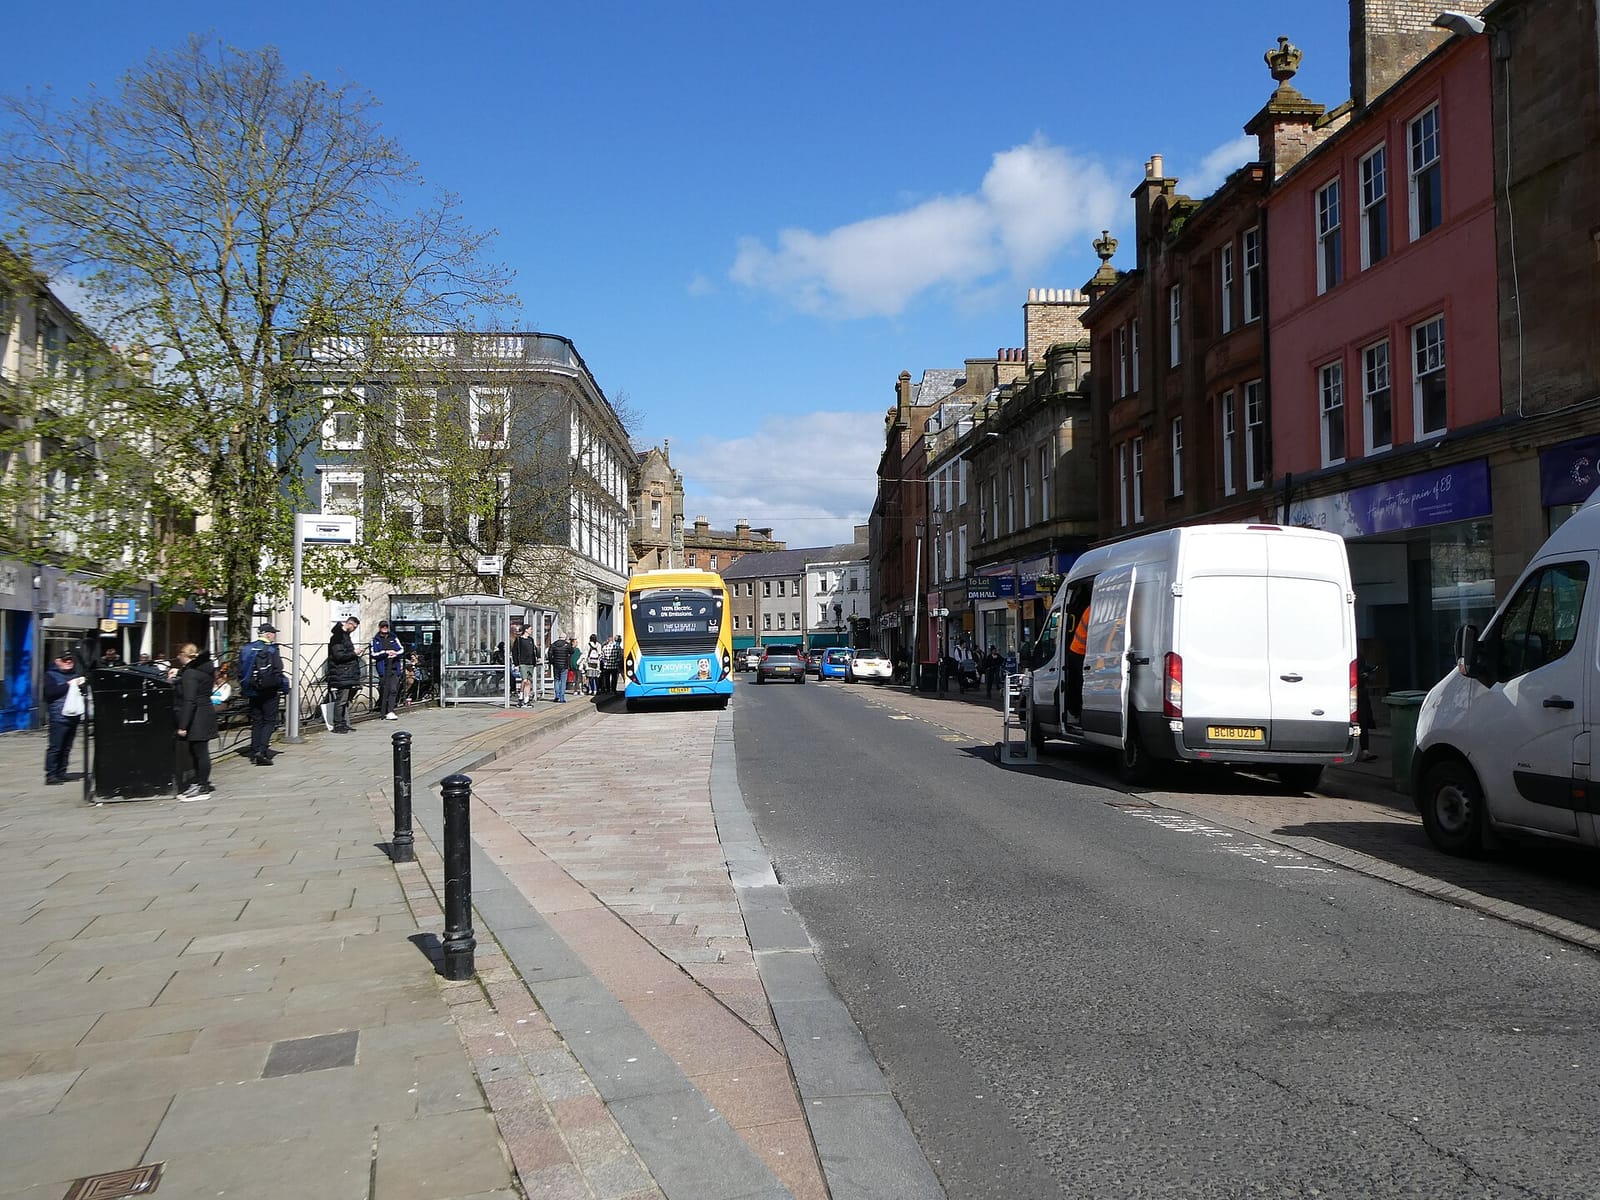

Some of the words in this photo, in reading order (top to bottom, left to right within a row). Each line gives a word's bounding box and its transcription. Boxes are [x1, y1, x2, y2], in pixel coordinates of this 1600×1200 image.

[1440, 474, 1452, 492] EB
[968, 577, 977, 585] To
[978, 577, 990, 585] Let
[1214, 727, 1235, 737] BC18
[1237, 728, 1256, 738] UZD
